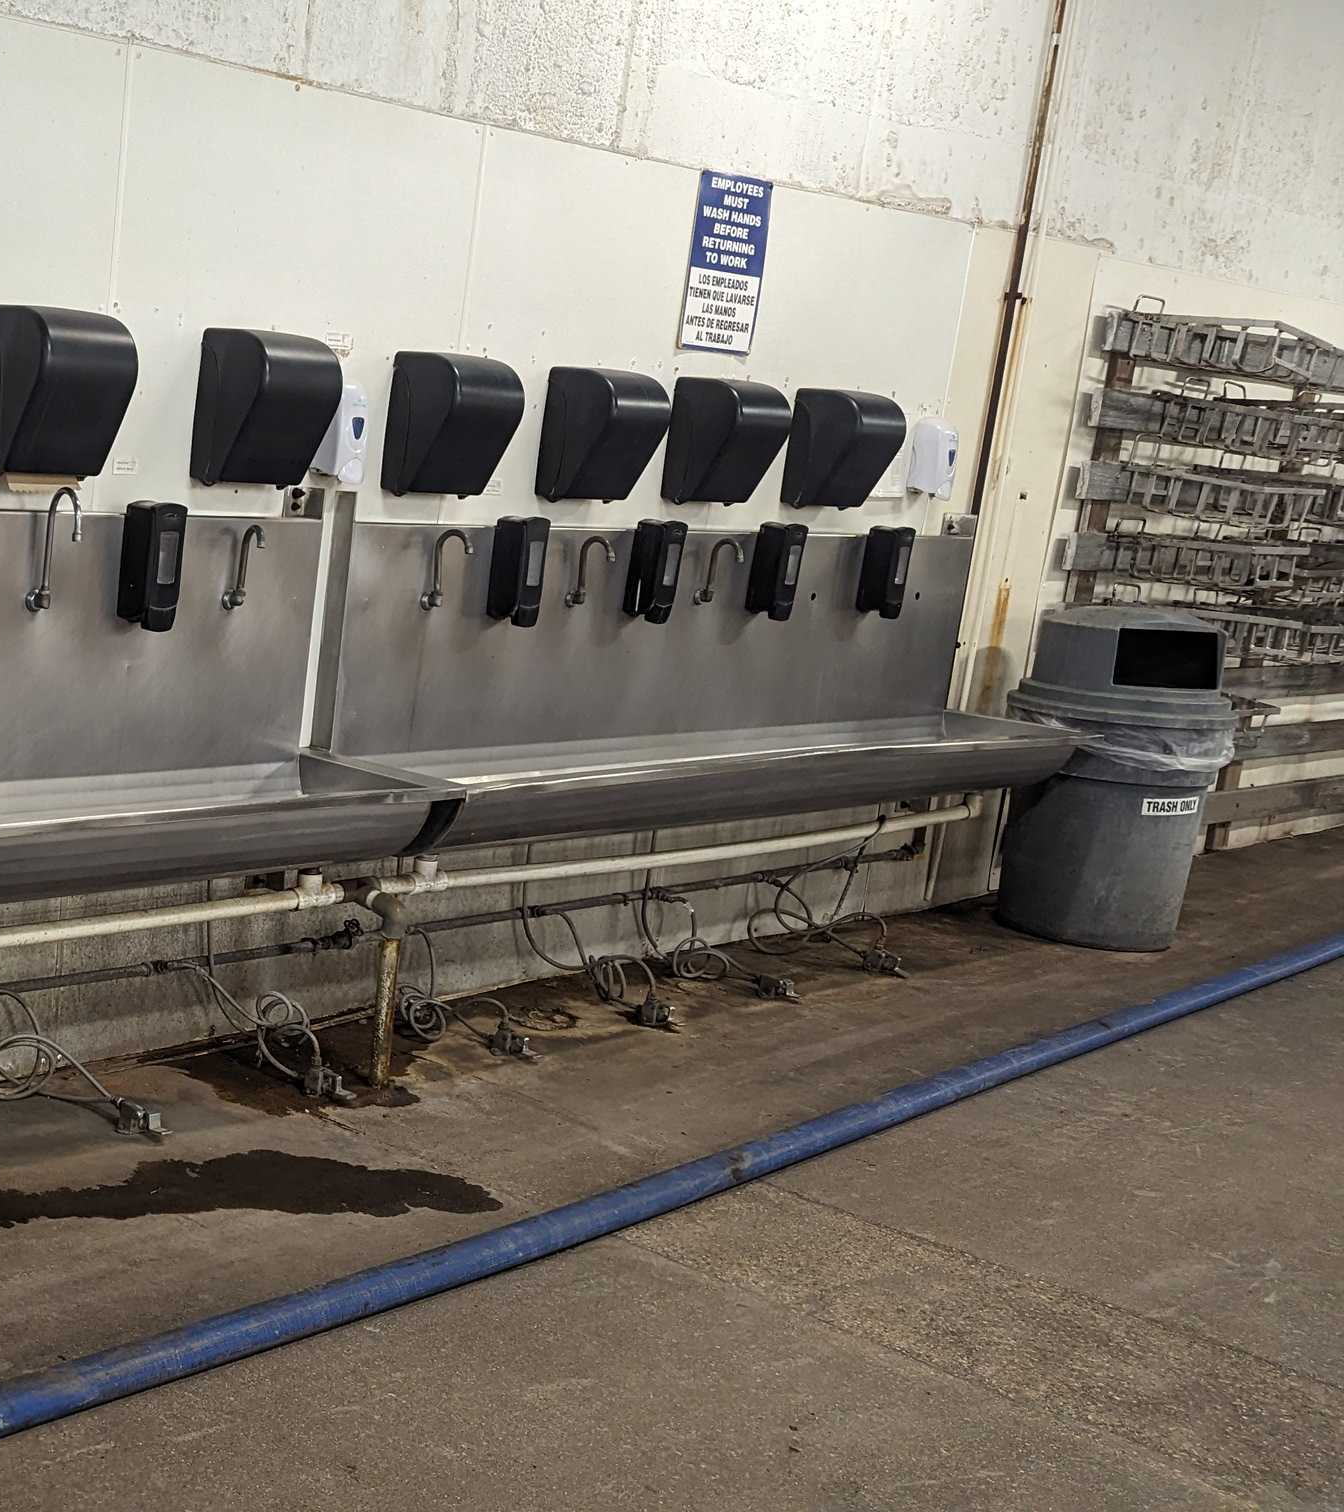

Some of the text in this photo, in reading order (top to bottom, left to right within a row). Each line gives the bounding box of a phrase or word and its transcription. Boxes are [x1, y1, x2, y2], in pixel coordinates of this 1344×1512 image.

[711, 176, 764, 198] EMPLOYEES
[723, 194, 749, 209] MUST
[703, 205, 761, 227] WASH HANDS
[713, 223, 749, 239] BEFORE
[702, 236, 755, 255] RETURNING
[706, 251, 748, 269] TO WORK
[698, 274, 748, 291] LOS EMPLEADOS
[689, 286, 755, 306] TIENEN QUE LAVARSE
[701, 303, 736, 318] LAS MANOS
[685, 314, 749, 333] ANTES DE REGRESAR
[695, 331, 733, 345] AL TRABAJO
[1146, 800, 1196, 813] TRASH ONLY
